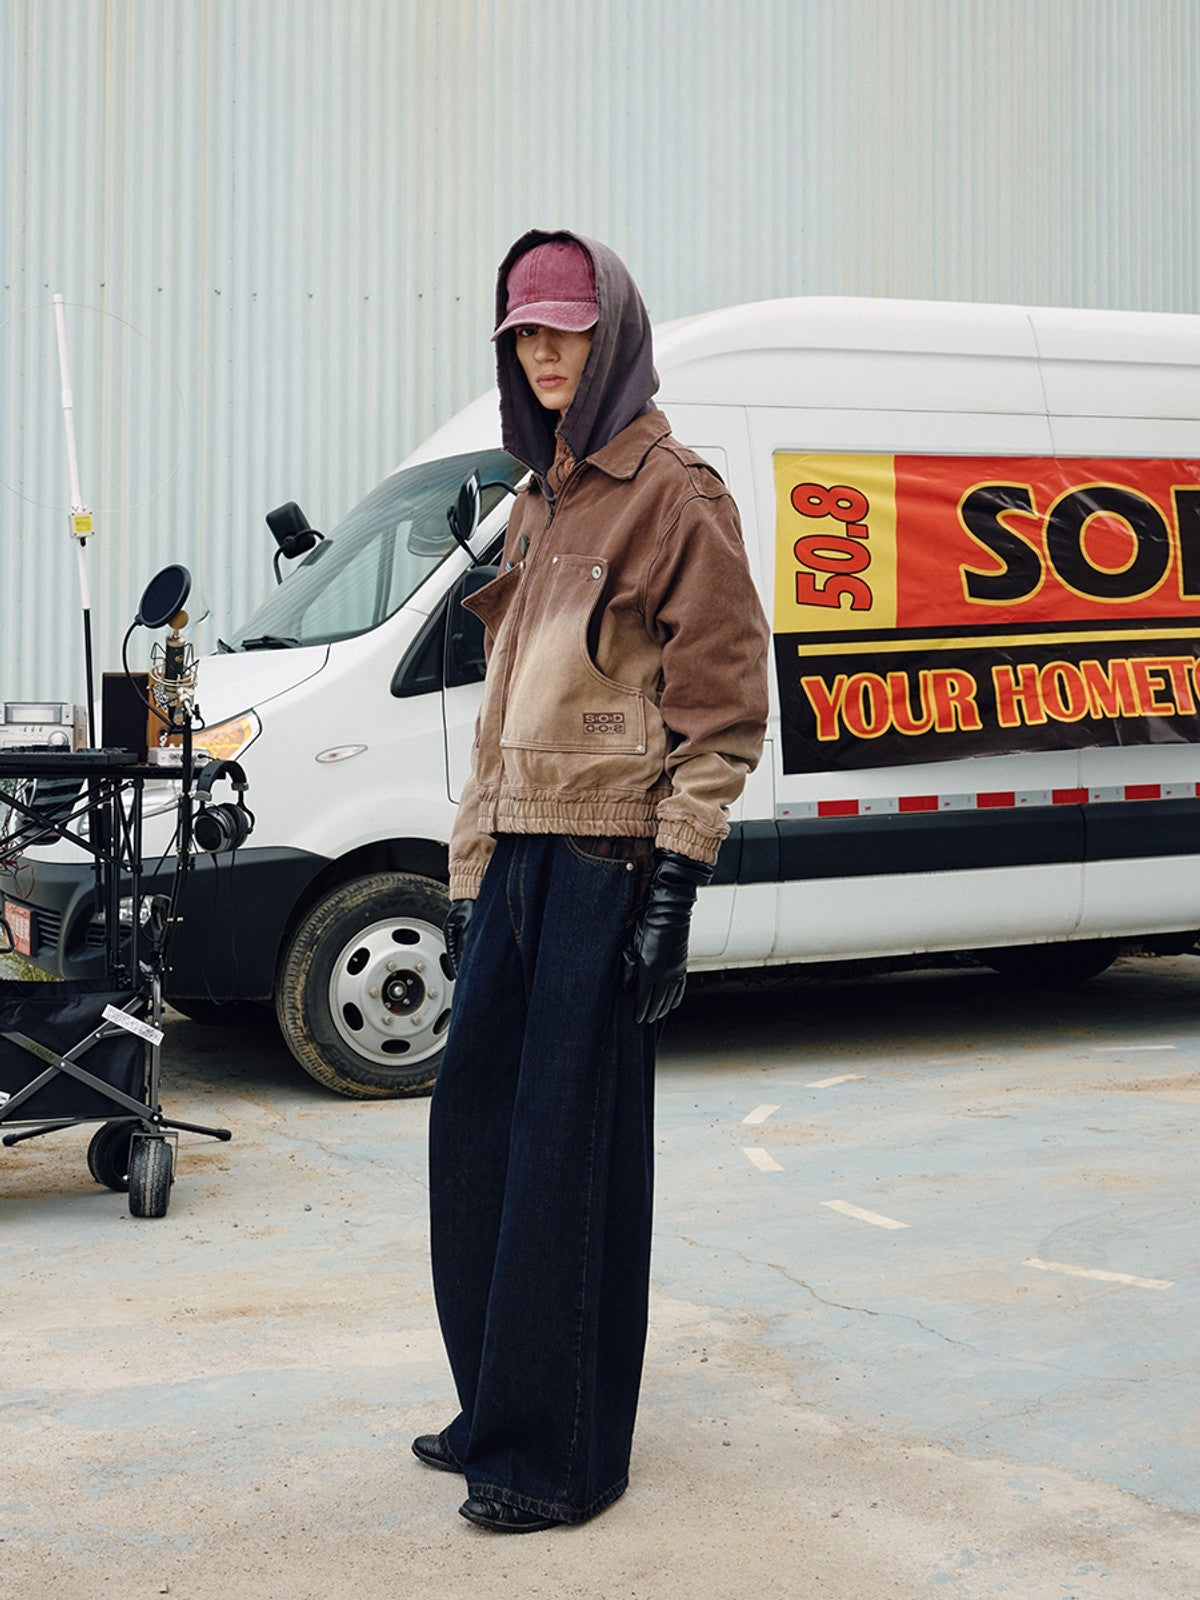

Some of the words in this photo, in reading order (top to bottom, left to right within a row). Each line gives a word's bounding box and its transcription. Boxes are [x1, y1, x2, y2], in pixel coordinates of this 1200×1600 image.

[790, 482, 873, 611] 50.8
[801, 668, 983, 742] YOUR
[992, 656, 1200, 728] HOMET
